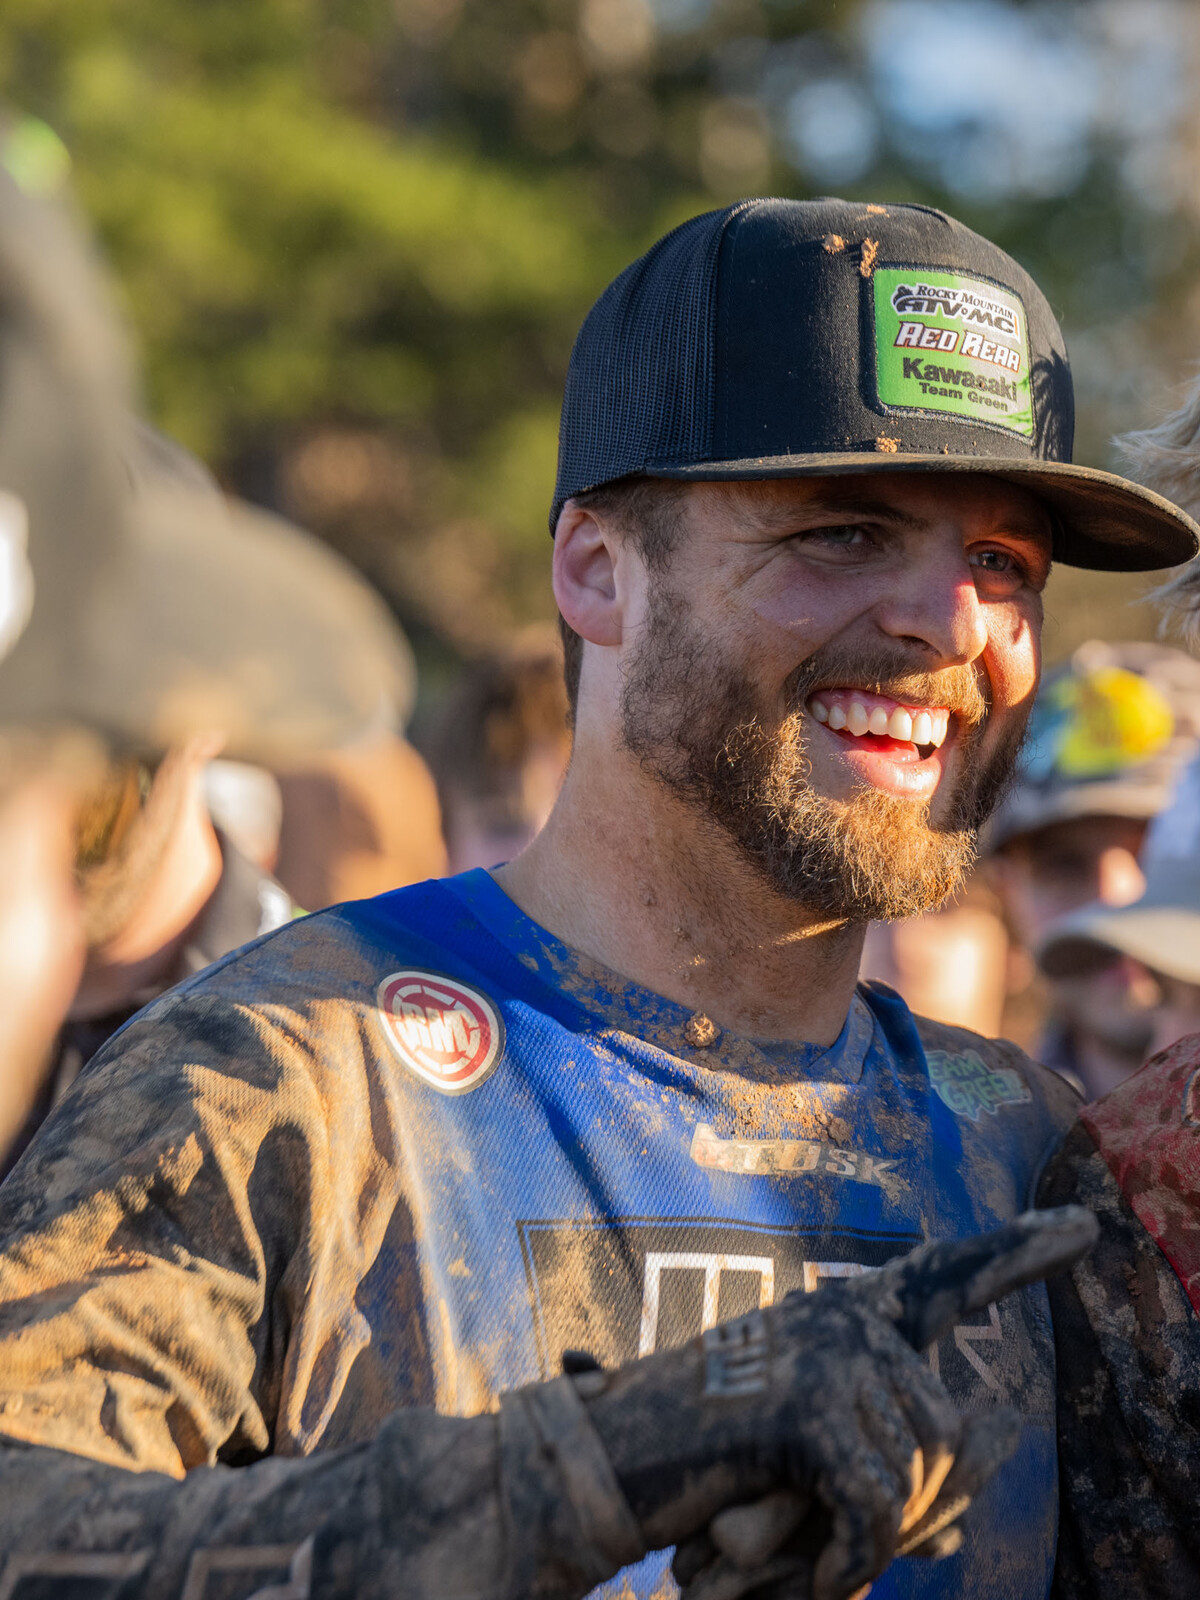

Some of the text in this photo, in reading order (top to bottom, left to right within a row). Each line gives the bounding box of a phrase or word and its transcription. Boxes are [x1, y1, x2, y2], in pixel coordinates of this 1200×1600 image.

[917, 285, 1013, 319] ROCKY MOUNTAIN
[893, 321, 960, 352] RED
[903, 357, 1018, 402] Kawasaki
[919, 382, 1008, 412] Team Green
[926, 1053, 988, 1077] EAM
[940, 1073, 1022, 1112] GREE
[737, 1143, 895, 1181] TUSK
